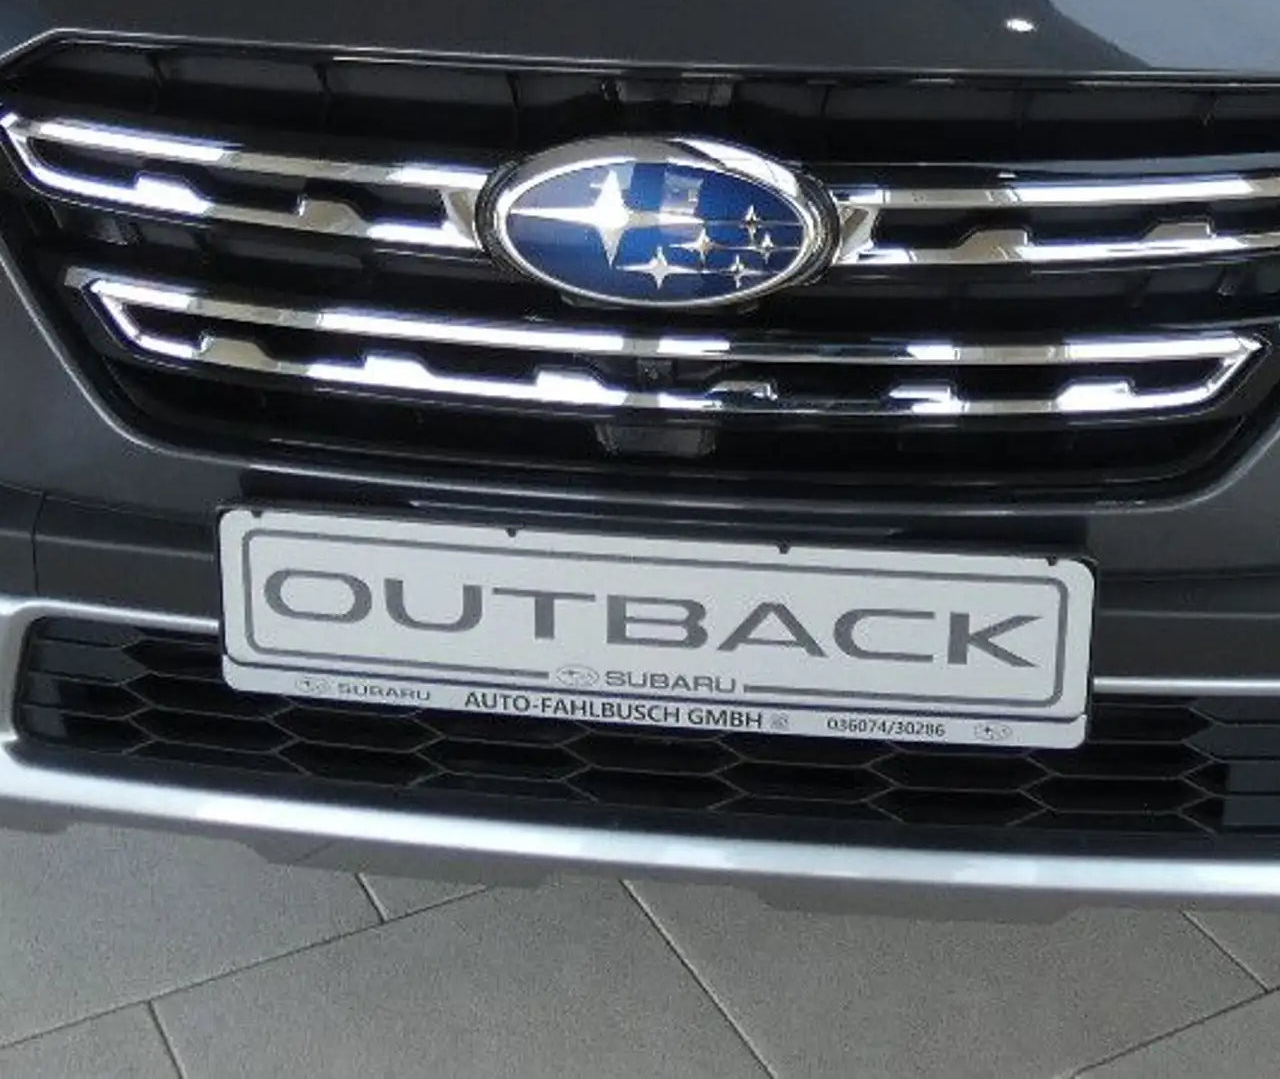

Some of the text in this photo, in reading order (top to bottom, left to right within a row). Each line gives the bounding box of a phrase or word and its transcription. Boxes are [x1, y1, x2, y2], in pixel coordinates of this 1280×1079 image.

[262, 567, 1045, 668] OUTBACK
[336, 682, 431, 702] SUBARU
[605, 670, 736, 694] SUBARU
[464, 690, 763, 729] AUTO-FAHLBUSCH GMBH
